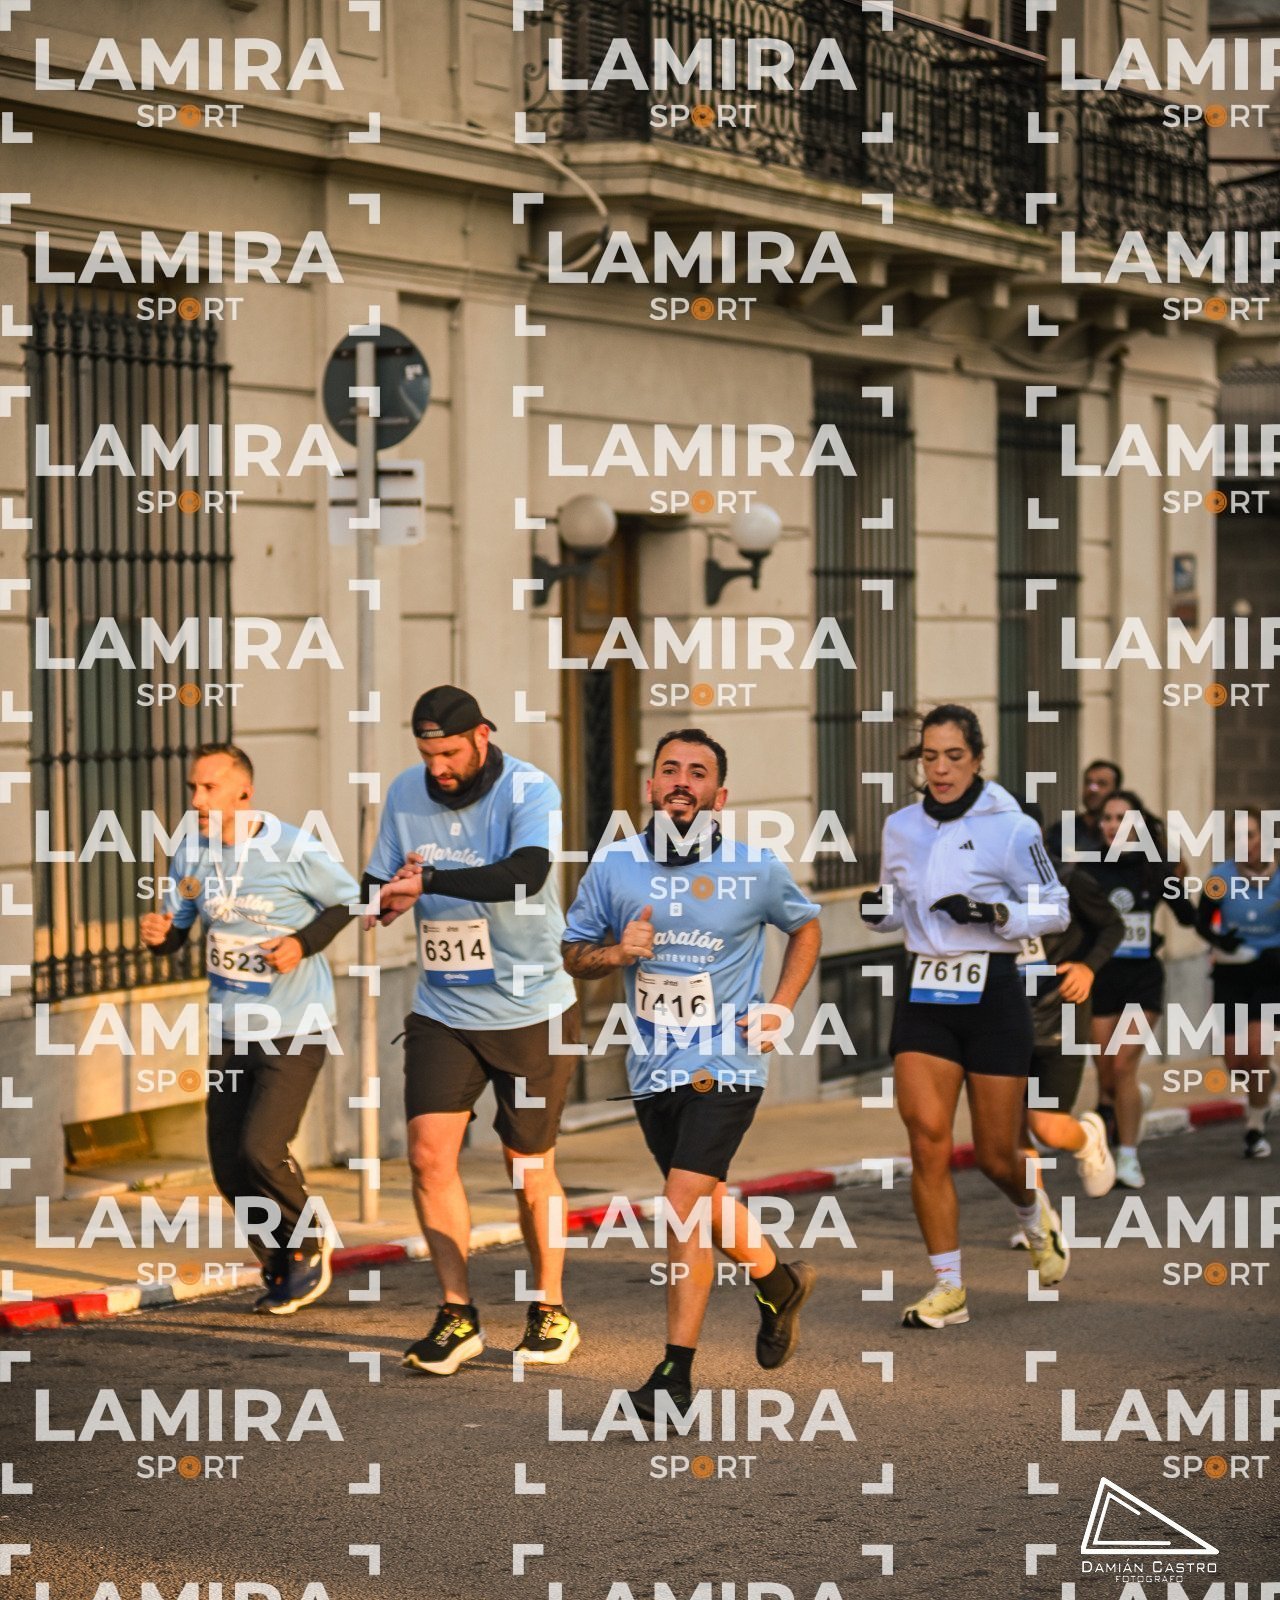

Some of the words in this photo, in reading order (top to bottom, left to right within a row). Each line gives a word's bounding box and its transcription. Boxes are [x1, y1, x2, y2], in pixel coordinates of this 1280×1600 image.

[426, 939, 485, 962] 6314
[653, 929, 725, 952] aratón
[210, 948, 266, 974] 6523
[650, 954, 716, 964] NTEVIDEO
[920, 960, 980, 984] 7616
[638, 988, 706, 1018] 7416
